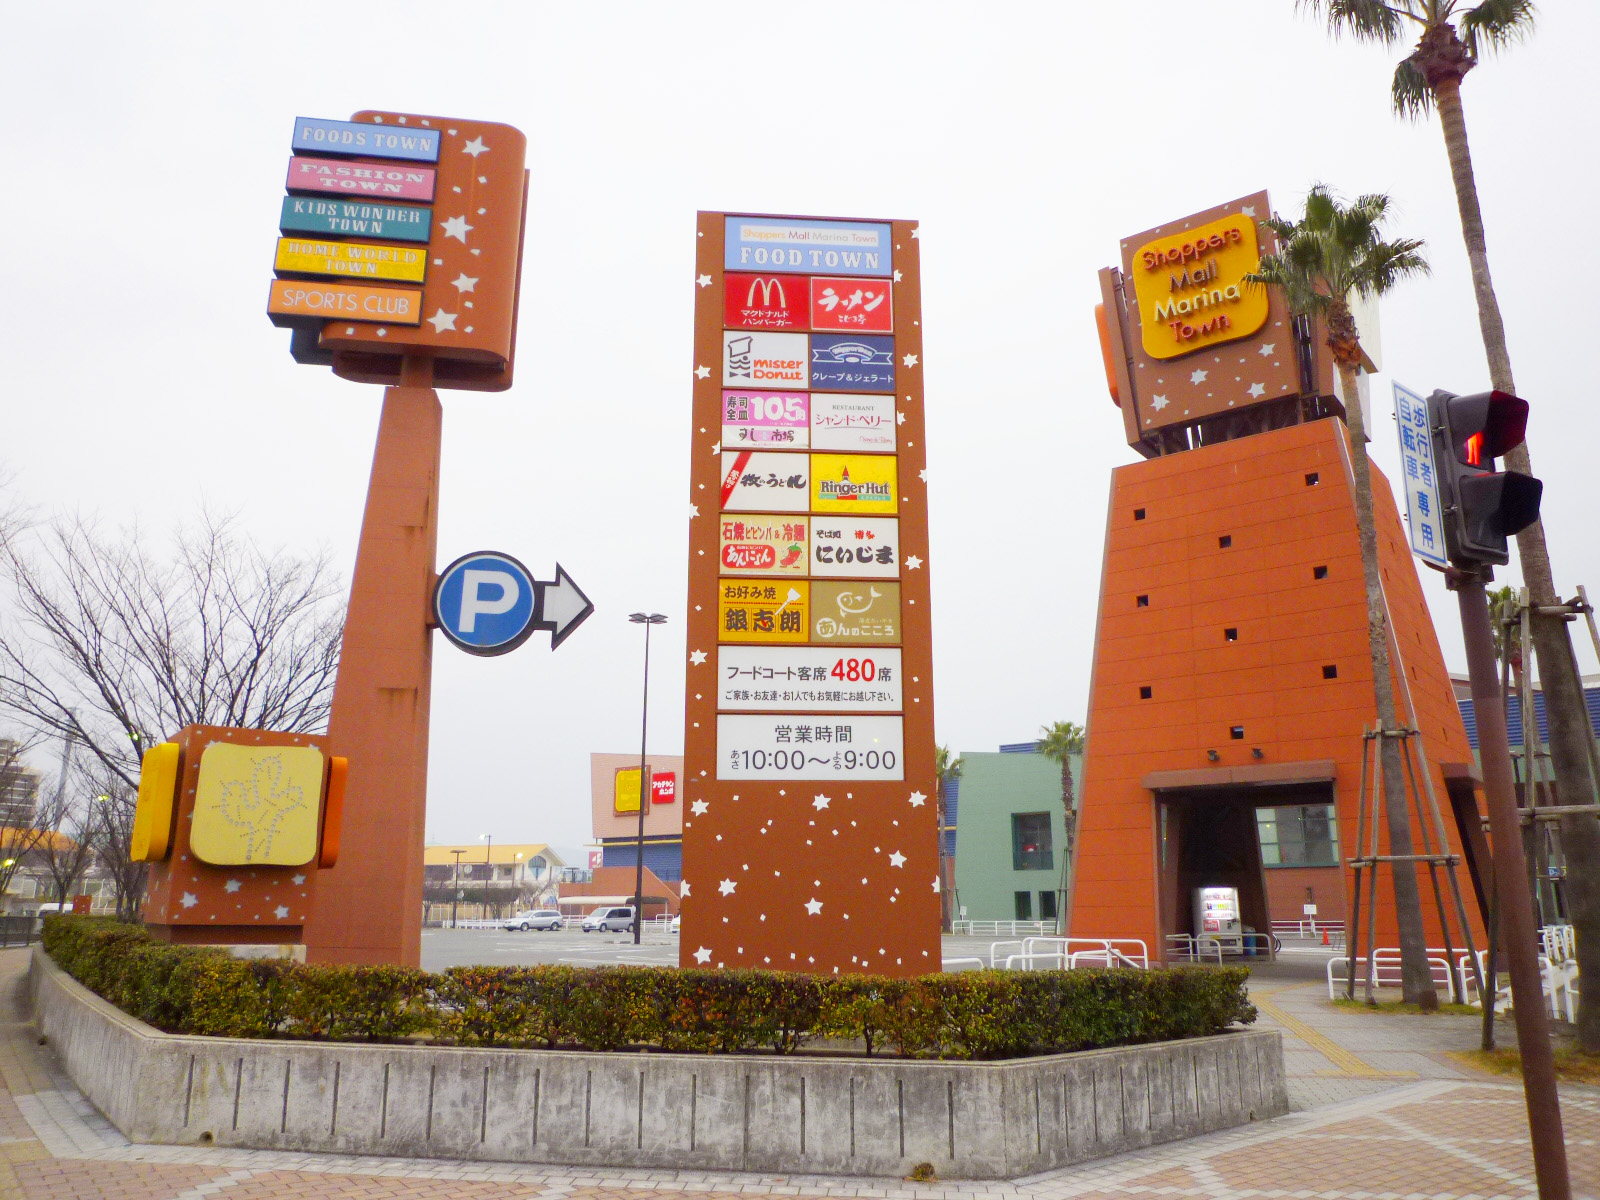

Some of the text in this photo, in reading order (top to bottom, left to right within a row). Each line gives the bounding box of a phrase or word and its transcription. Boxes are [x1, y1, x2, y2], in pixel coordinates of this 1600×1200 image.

[302, 127, 432, 151] FOODS TOWN
[299, 164, 425, 183] FASHION
[319, 177, 403, 193] TOWN
[294, 201, 420, 223] KIDS WONDER
[329, 218, 383, 234] TOWN
[743, 229, 877, 243] Shoppers Mall Marina Town
[288, 242, 417, 264] HOME WORLD
[740, 247, 879, 269] FOOD TOWN
[1142, 227, 1241, 270] Shoppers
[325, 258, 377, 274] TOWN
[1169, 258, 1218, 293] Mall
[282, 289, 410, 315] SPORTS CLUB
[818, 287, 885, 312] ラーメン
[1154, 284, 1241, 321] Marina
[740, 309, 789, 318] マクドナルド
[742, 317, 793, 326] ハンバーガー
[1169, 314, 1230, 342] Town
[754, 370, 804, 380] Donut
[727, 396, 748, 409] 寿司
[726, 409, 749, 421] 全皿
[740, 473, 807, 489] 牧のうどん
[820, 481, 889, 495] Ringer Hut
[855, 530, 875, 540] 博多
[727, 545, 771, 567] あんにょん
[816, 545, 894, 564] にいじま
[459, 569, 519, 633] P
[725, 586, 776, 599] お好み焼
[726, 608, 801, 632] 銀志朗
[774, 725, 852, 744] 営業時間
